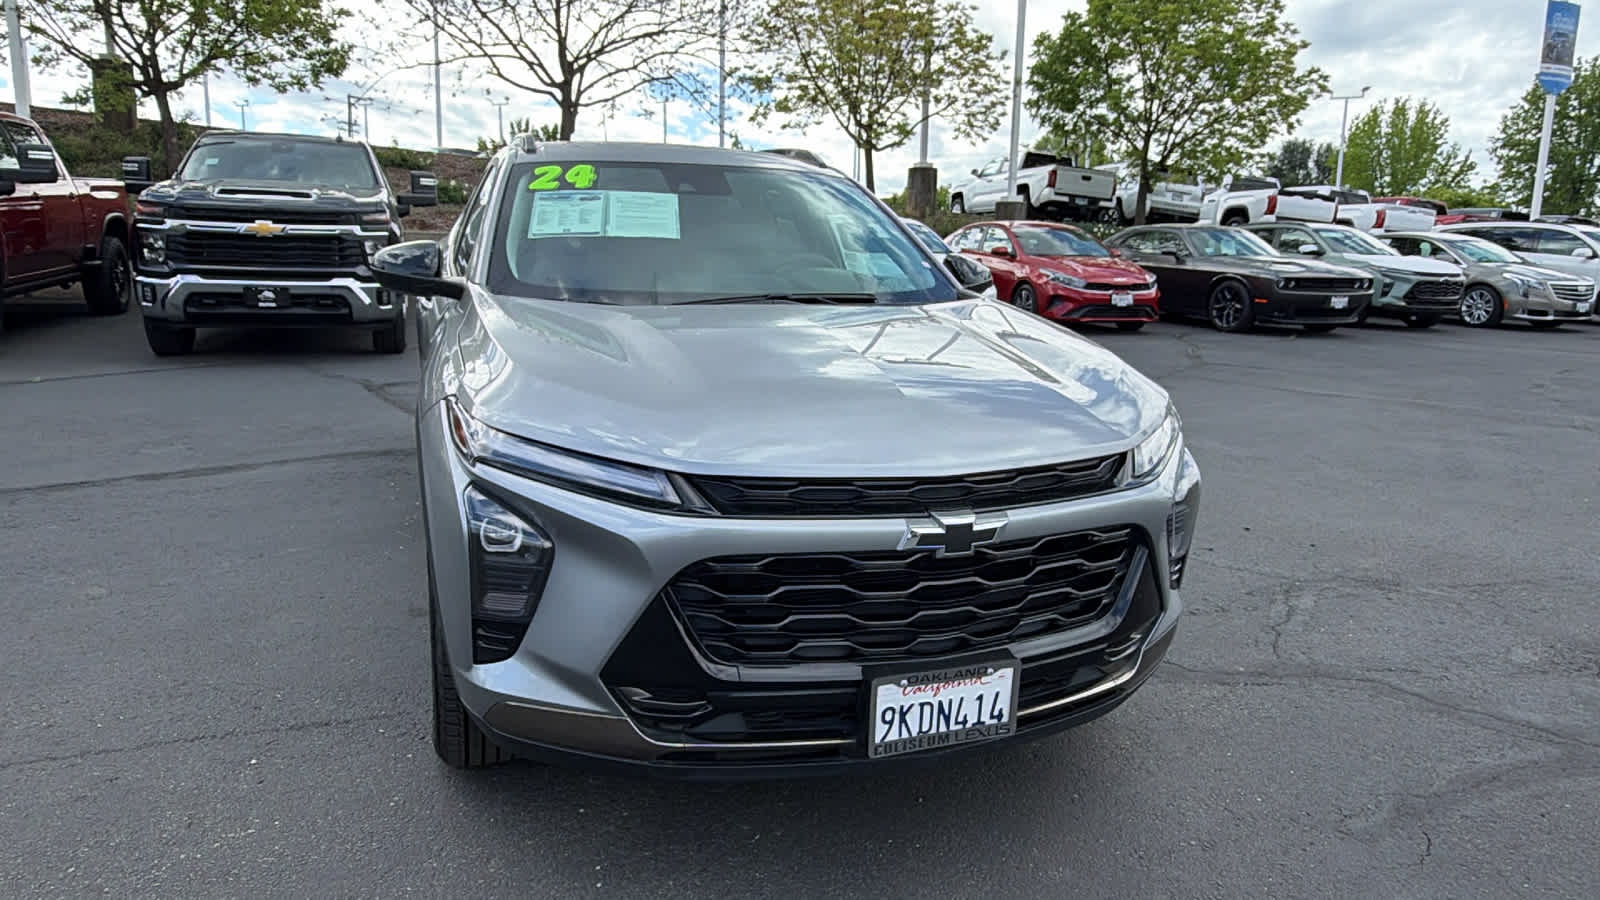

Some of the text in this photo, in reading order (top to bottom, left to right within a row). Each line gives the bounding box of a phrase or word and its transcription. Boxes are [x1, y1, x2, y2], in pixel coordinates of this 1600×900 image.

[529, 164, 597, 190] 24
[902, 675, 991, 697] California
[907, 667, 988, 684] OAKLAND
[881, 691, 1004, 742] 9KDN414
[874, 724, 1010, 756] COLISEUM LEXUS
